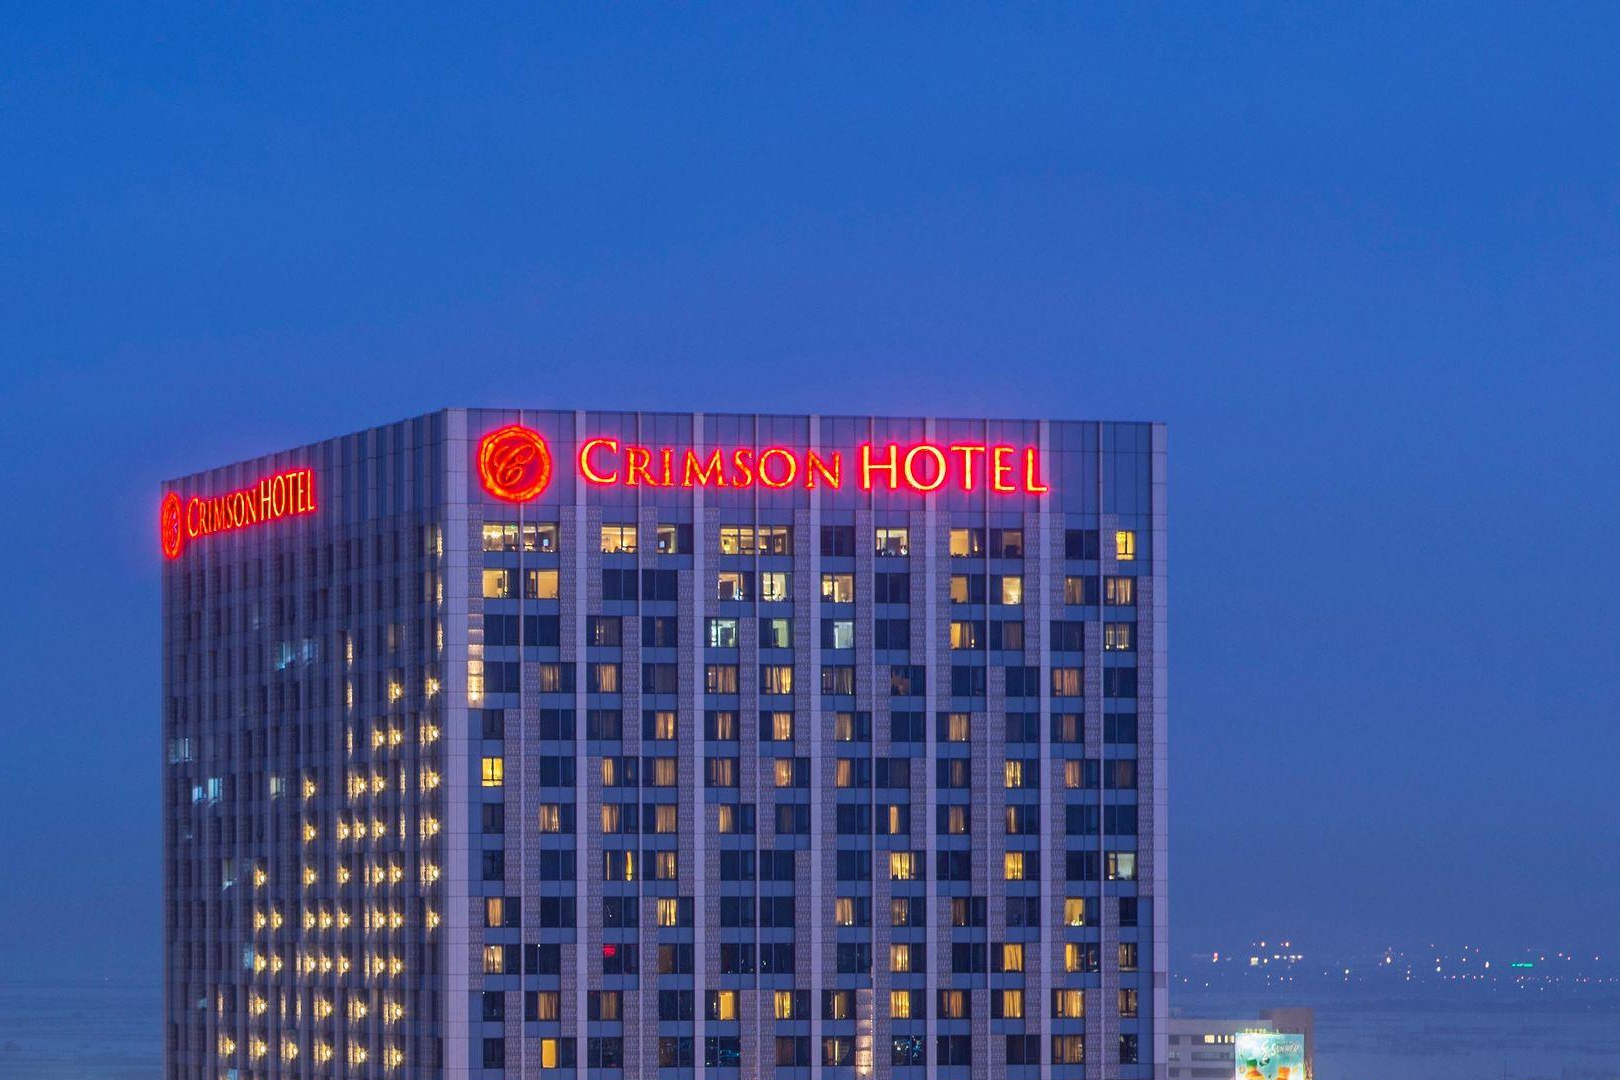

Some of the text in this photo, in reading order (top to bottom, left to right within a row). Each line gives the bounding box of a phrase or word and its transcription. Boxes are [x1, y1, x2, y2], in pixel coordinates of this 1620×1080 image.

[580, 439, 1049, 492] CRIMSON HOTEL
[187, 470, 315, 538] CRIMSON HOTEL
